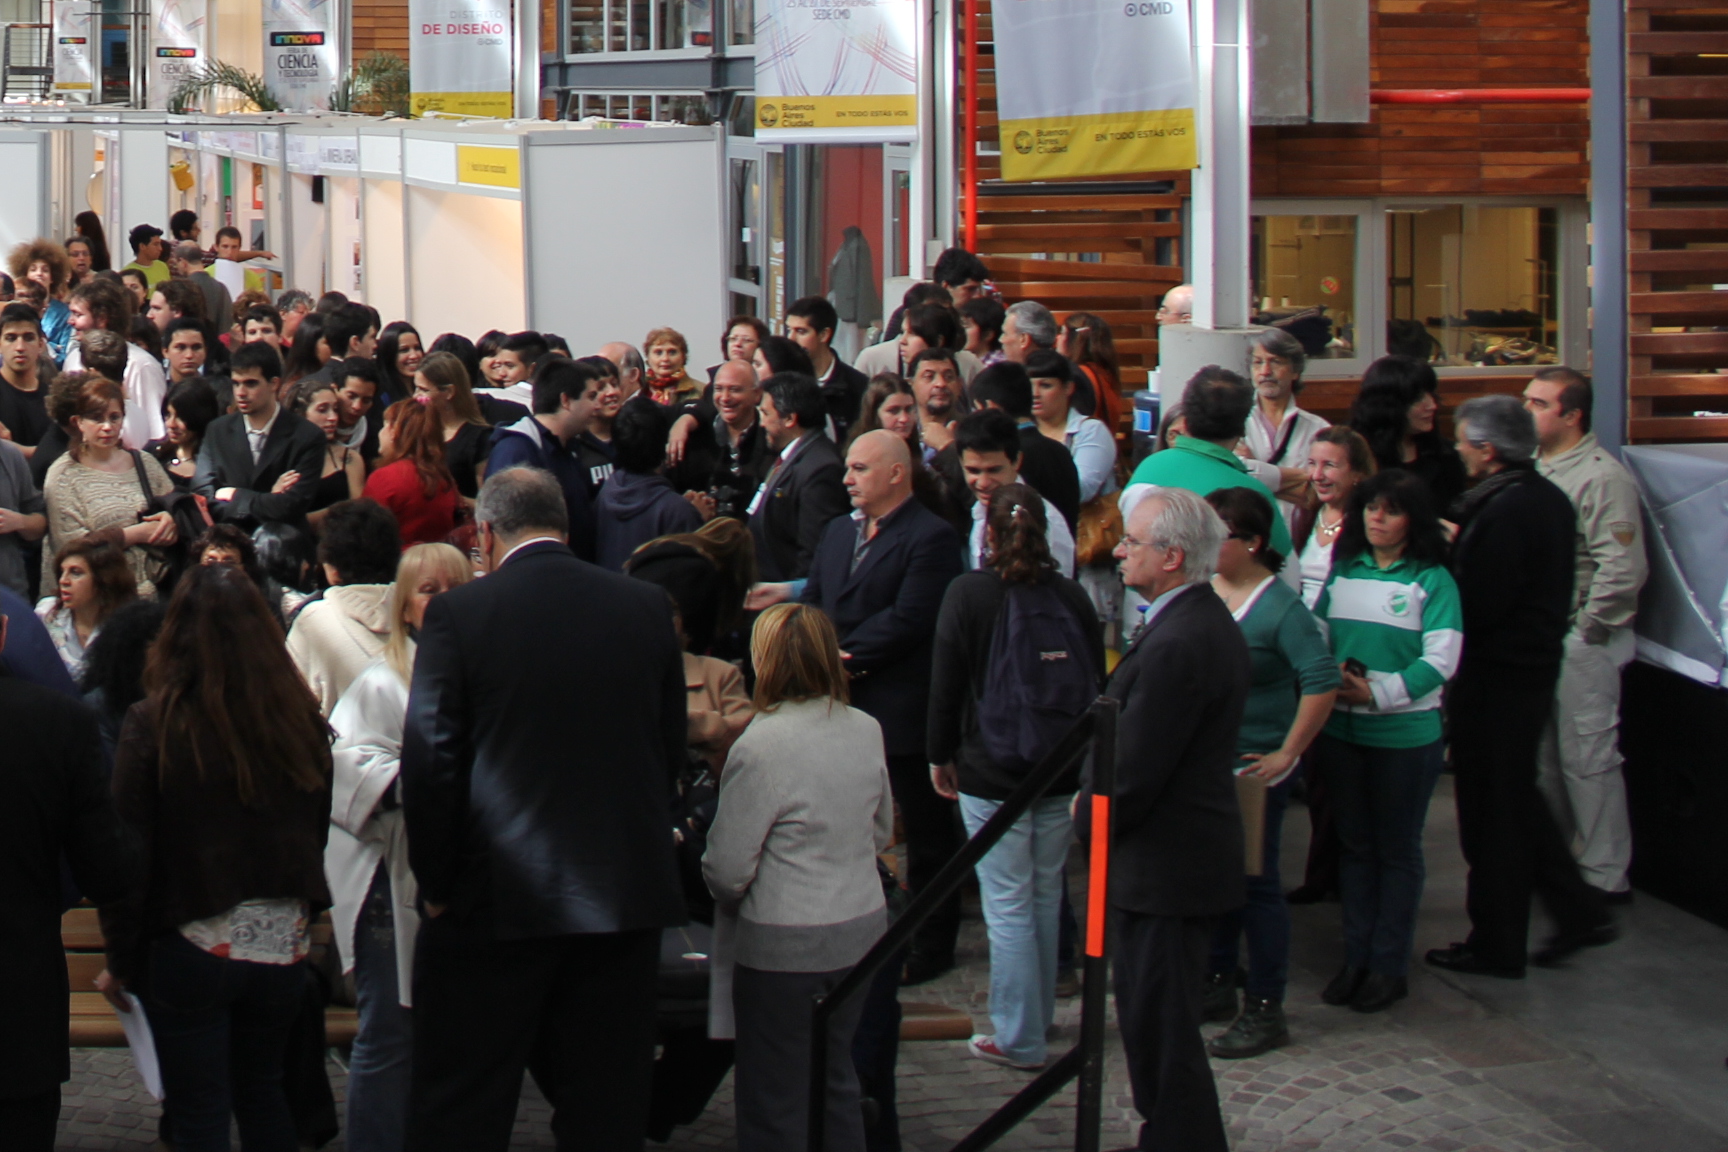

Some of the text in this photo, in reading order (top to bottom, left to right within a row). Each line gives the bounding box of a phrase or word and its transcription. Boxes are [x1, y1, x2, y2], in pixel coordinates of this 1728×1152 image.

[1139, 2, 1173, 16] CMD
[450, 10, 503, 19] DISTRITO
[813, 9, 851, 20] SEDE CMD
[422, 21, 503, 35] DE DISEÑO
[278, 54, 318, 69] CIENCIA
[781, 103, 815, 111] Buenos
[1036, 128, 1069, 137] Buenos
[1095, 133, 1107, 142] EN
[1110, 131, 1135, 141] TODO
[1167, 127, 1186, 137] VOS
[1036, 137, 1059, 145] Aires
[1036, 145, 1068, 154] Ciudad
